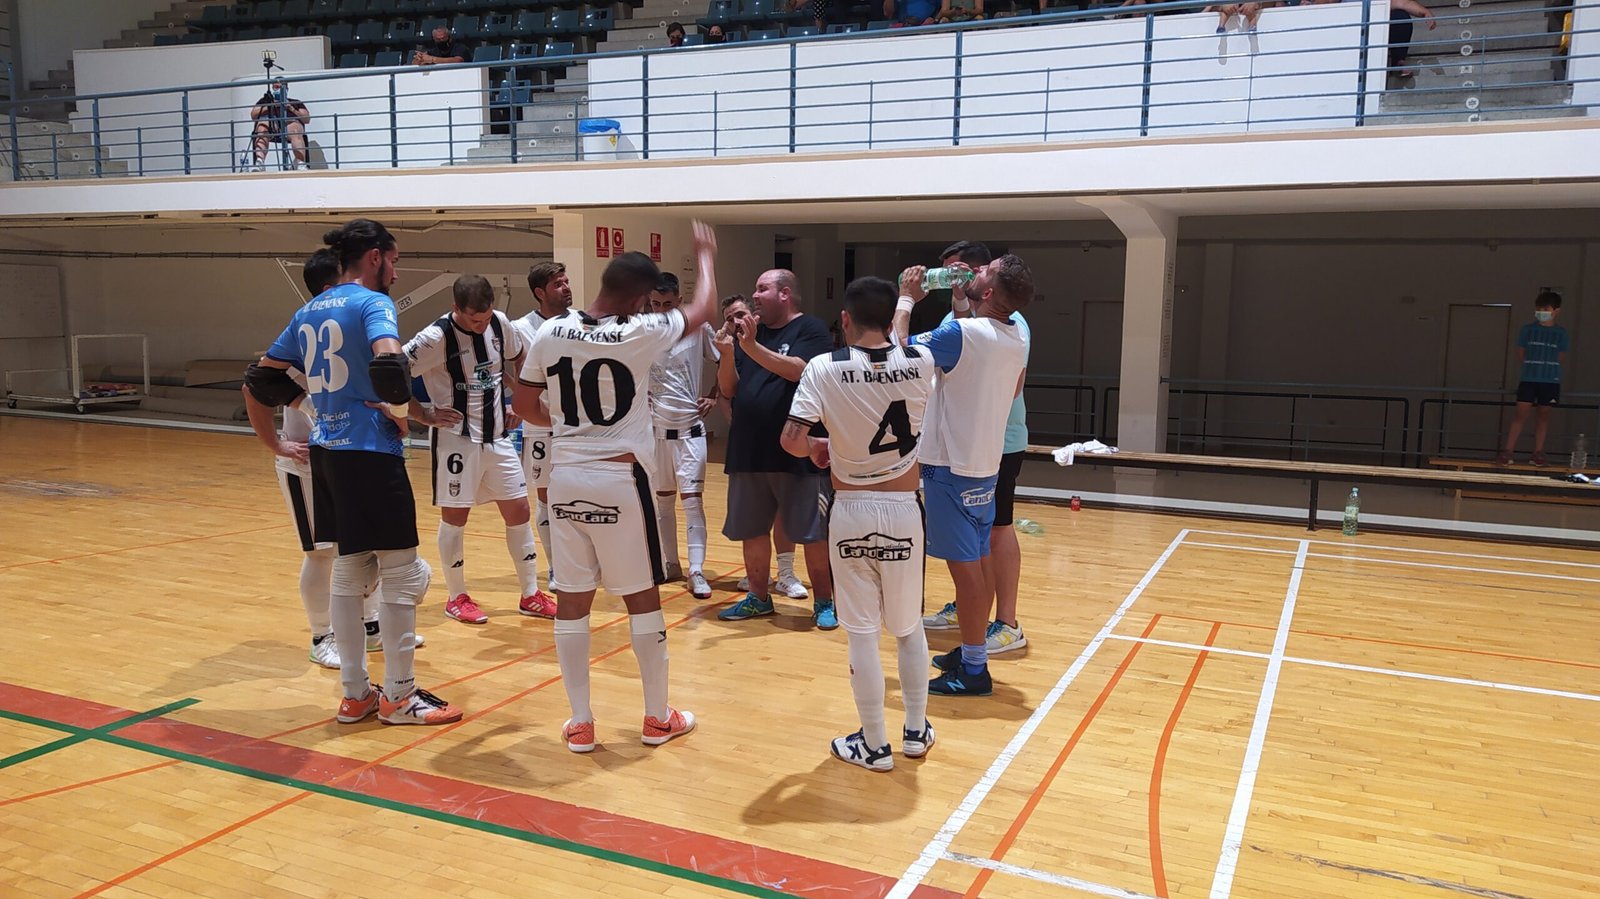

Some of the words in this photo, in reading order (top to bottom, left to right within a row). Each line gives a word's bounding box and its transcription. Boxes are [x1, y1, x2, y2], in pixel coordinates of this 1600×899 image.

[551, 326, 564, 338] AT.
[298, 318, 349, 394] 23
[841, 371, 860, 383] AT.
[547, 356, 636, 427] 10
[869, 399, 921, 458] 4
[532, 441, 546, 460] 8
[447, 453, 463, 474] 6
